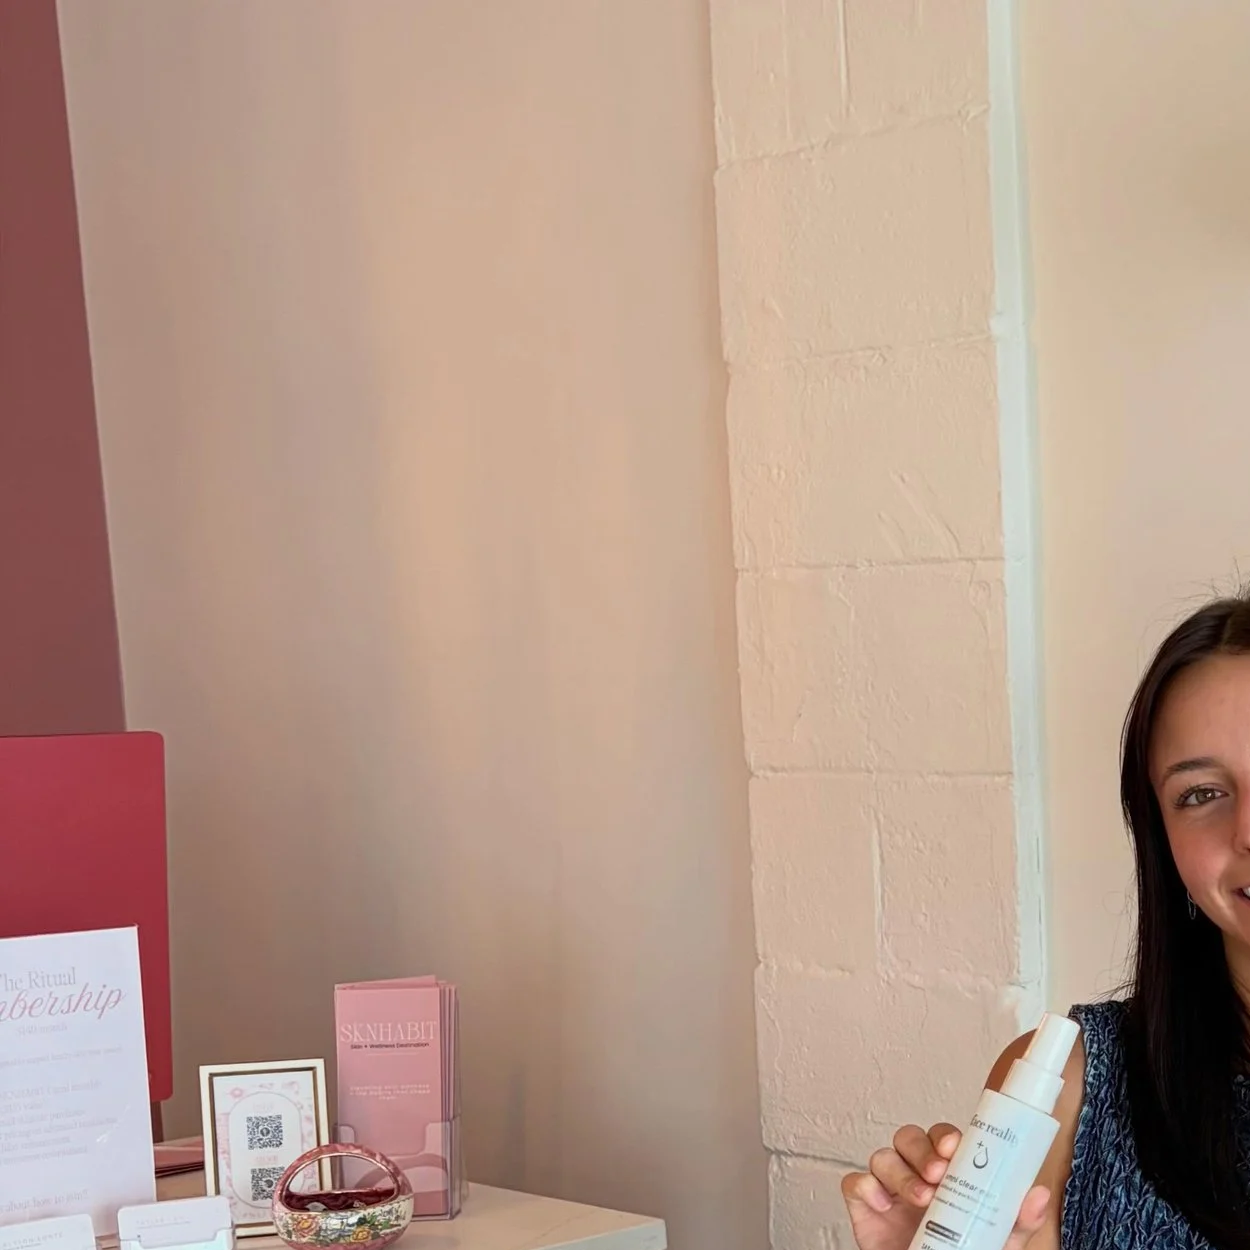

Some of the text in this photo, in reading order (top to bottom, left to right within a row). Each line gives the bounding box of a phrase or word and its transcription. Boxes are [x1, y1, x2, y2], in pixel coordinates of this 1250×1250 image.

[0, 966, 76, 991] he Ritual
[0, 982, 126, 1020] bership
[340, 1020, 437, 1043] SKNHABIT
[970, 1114, 986, 1131] face
[958, 1179, 978, 1192] clear
